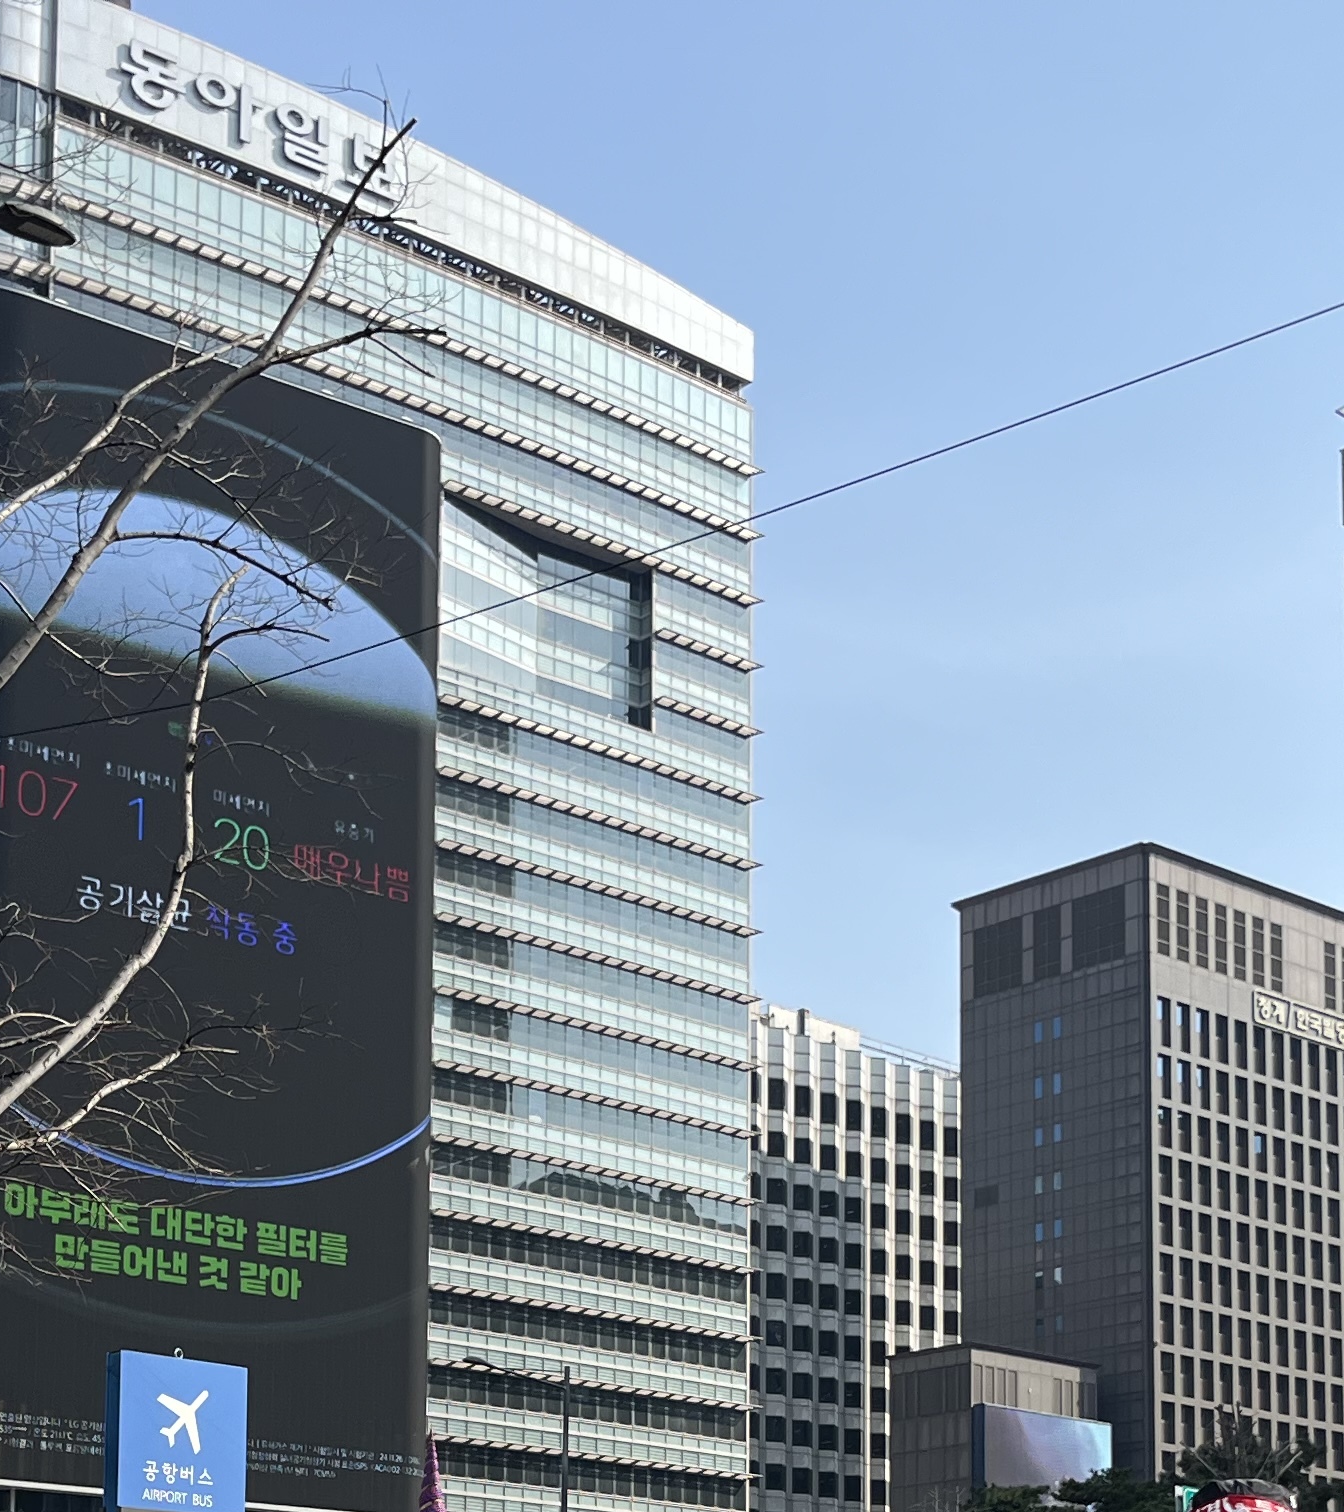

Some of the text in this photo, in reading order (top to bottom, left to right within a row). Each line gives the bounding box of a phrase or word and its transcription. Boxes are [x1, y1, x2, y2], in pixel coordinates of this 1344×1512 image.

[120, 38, 407, 202] 동아일보
[128, 798, 144, 840] 1
[214, 818, 269, 870] 20
[207, 906, 258, 947] 작동
[273, 920, 298, 956] 중
[5, 1183, 348, 1267] 아무래도 대단한 필터를
[55, 1233, 303, 1301] 만들어낸 것 같아
[142, 1488, 213, 1508] AIRPORT BUS
[143, 1460, 214, 1486] 공항버스
